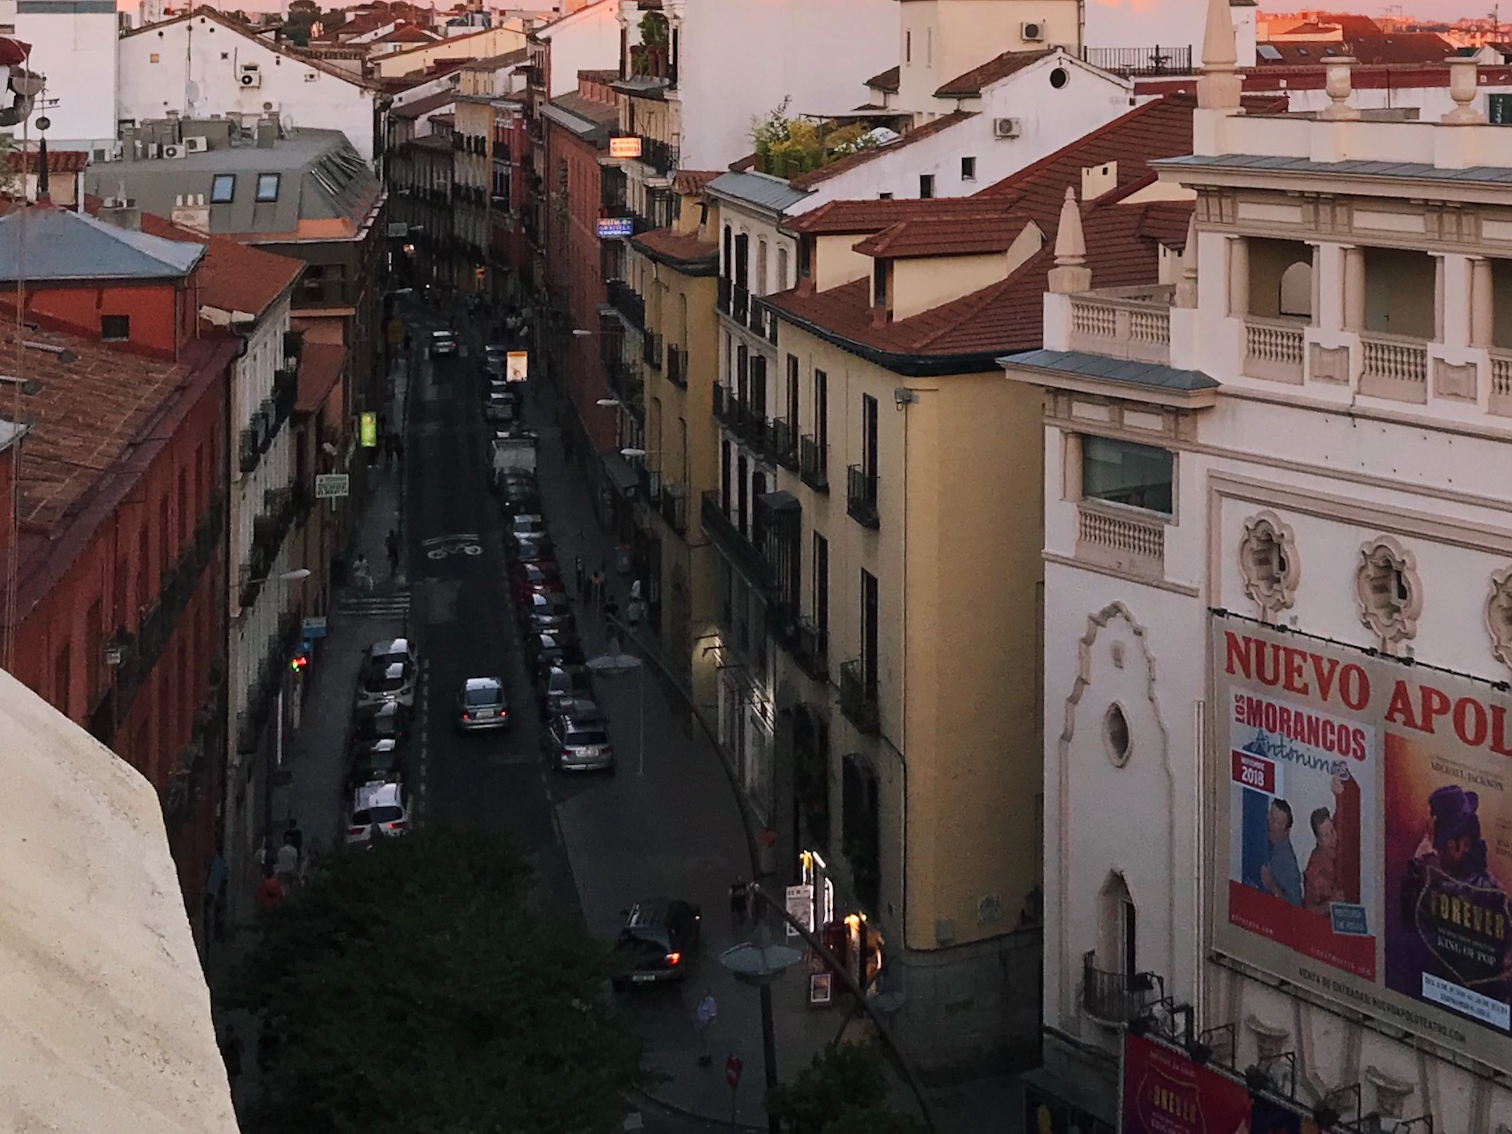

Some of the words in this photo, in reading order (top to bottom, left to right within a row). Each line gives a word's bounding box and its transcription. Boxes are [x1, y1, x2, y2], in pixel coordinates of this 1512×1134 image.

[1224, 631, 1370, 711] NUEVO
[1235, 694, 1245, 723] LOS
[1246, 696, 1366, 762] MORANCOS
[1241, 766, 1265, 787] 2018
[1430, 890, 1505, 940] FOREVER
[1437, 935, 1462, 954] KING
[1463, 946, 1475, 959] OF
[1477, 950, 1497, 966] POP
